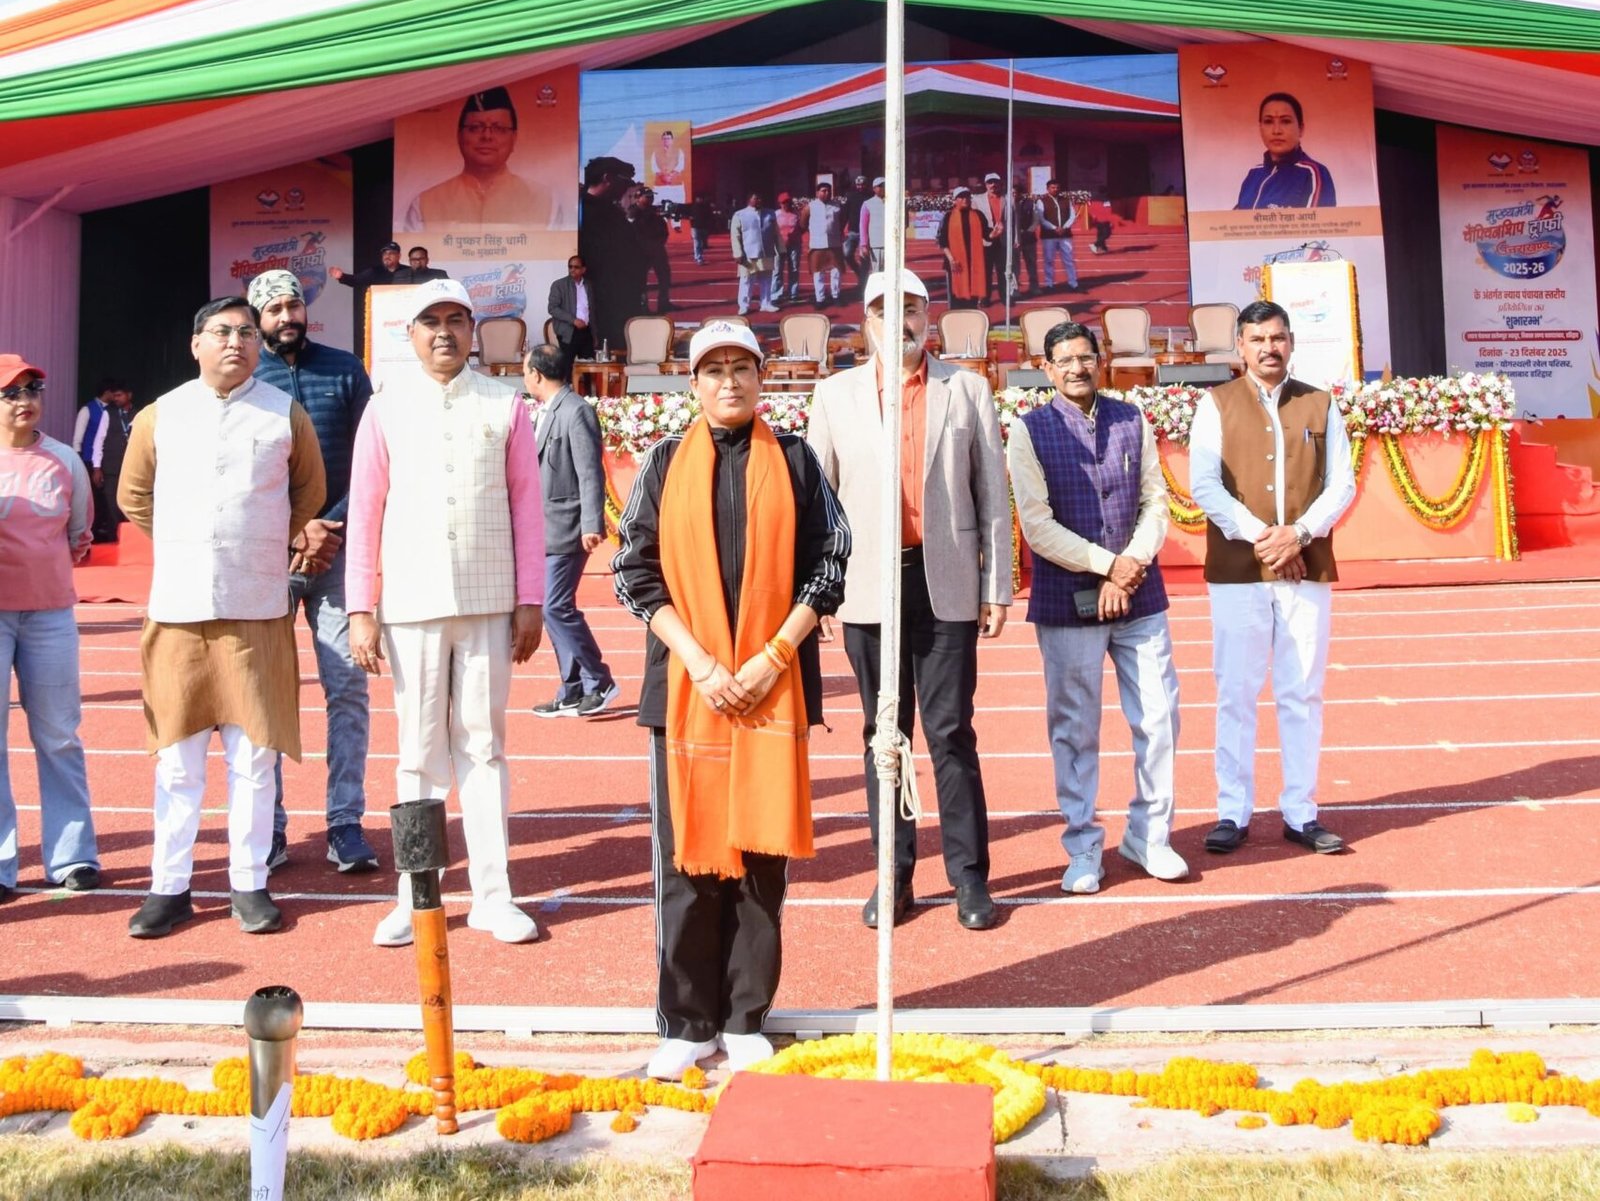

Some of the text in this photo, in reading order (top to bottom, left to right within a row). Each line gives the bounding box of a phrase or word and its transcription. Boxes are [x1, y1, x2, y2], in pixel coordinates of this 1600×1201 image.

[1253, 212, 1277, 222] श्रीमती
[1279, 212, 1295, 221] रेखा
[443, 233, 527, 248] श्री पुष्कर सिंह धामी
[1504, 263, 1545, 275] 2025-26
[1479, 347, 1502, 357] दिनांक
[1510, 348, 1520, 357] 23
[1521, 347, 1545, 357] दिसंबर
[1547, 348, 1568, 357] 2025
